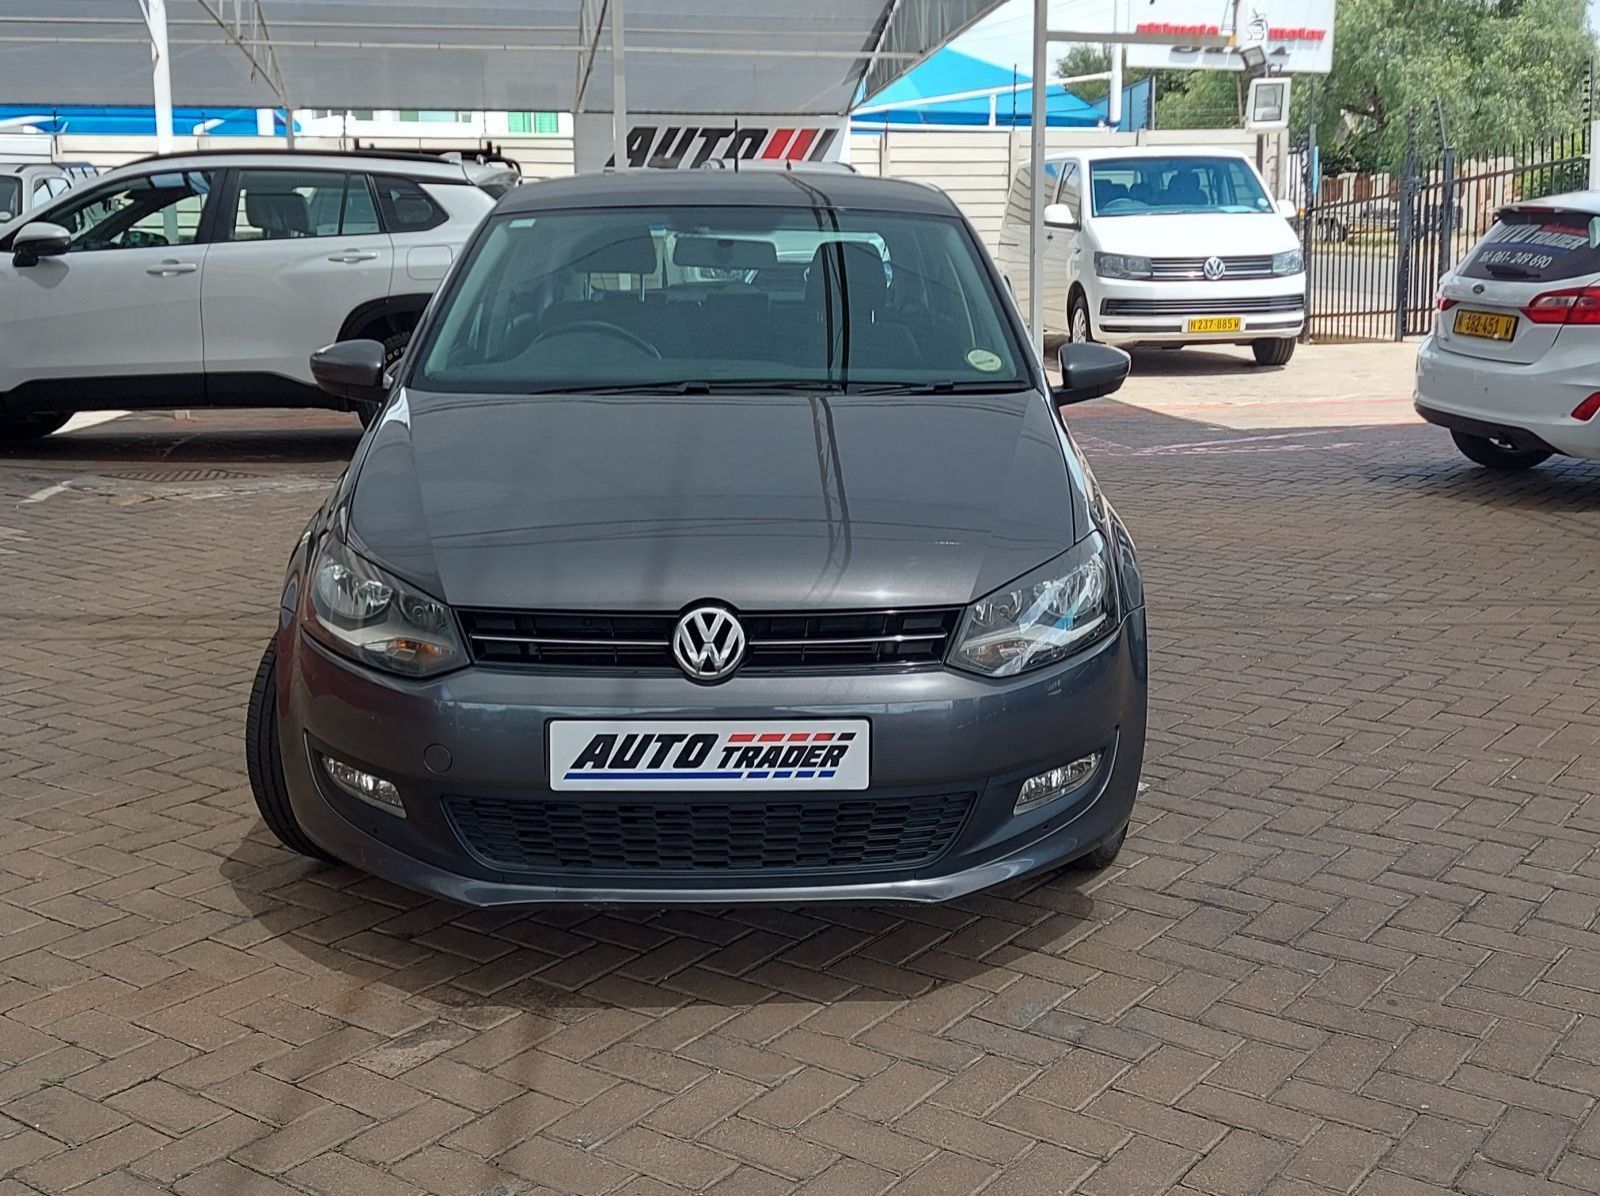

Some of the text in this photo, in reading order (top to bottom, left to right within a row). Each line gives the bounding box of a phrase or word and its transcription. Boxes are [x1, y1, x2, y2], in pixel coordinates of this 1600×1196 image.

[604, 126, 769, 168] AUTO
[1529, 255, 1553, 268] 690
[570, 734, 850, 769] AUTO TRADER
